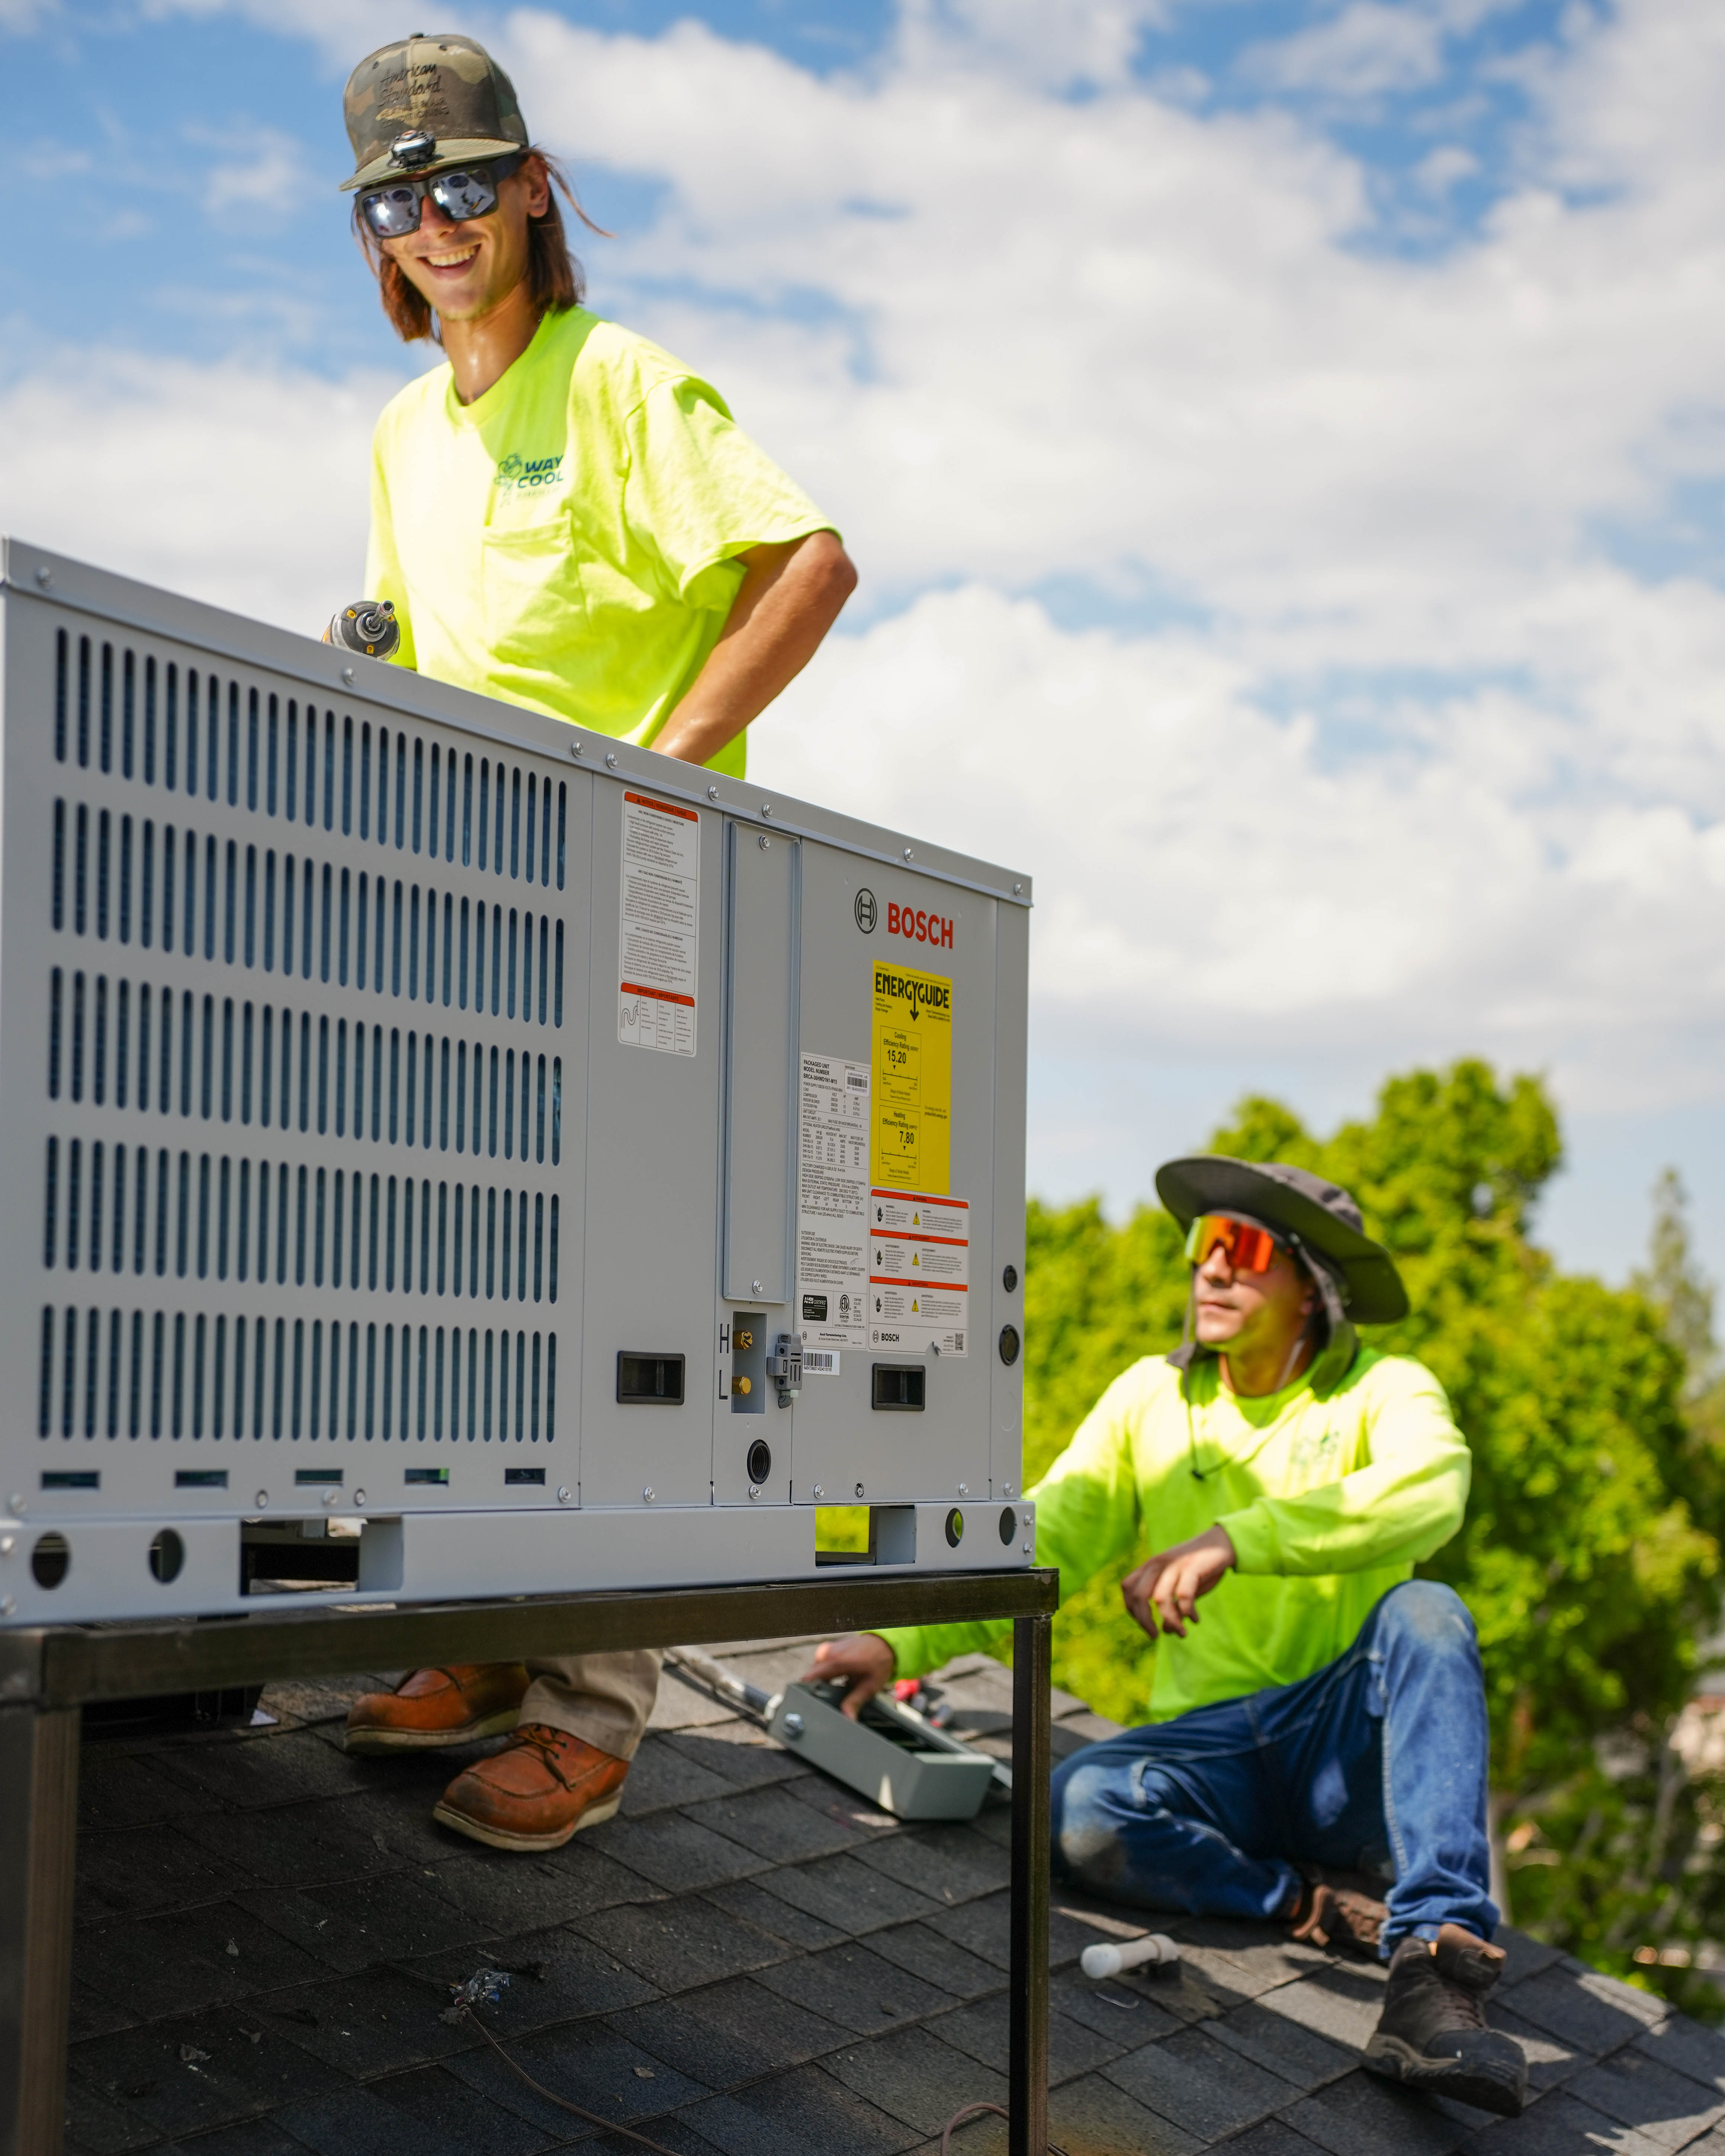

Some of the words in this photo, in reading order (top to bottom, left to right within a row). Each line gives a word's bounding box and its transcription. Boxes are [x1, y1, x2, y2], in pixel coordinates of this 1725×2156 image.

[380, 64, 436, 84] American
[378, 75, 442, 107] Standard
[525, 455, 563, 473] WAY
[518, 471, 564, 488] COOL
[656, 804, 674, 813] REMARQUE
[888, 902, 953, 949] BOSCH
[637, 988, 655, 996] IMPORTANT
[658, 992, 678, 1001] IMPORTANTE
[876, 972, 949, 1009] ENERGYGUIDE
[894, 1032, 906, 1041] Cooling
[884, 1038, 899, 1048] Efficiency
[900, 1042, 909, 1051] Rating
[803, 1059, 821, 1067] PACKAGED
[887, 1049, 906, 1064] 15.20
[803, 1073, 837, 1084] BRCA-36HWD1N1-M15
[893, 1111, 905, 1120] Heating
[883, 1118, 897, 1128] Efficiency
[899, 1121, 908, 1130] Rating
[900, 1131, 914, 1144] 7.80
[881, 1333, 899, 1342] BOSCH
